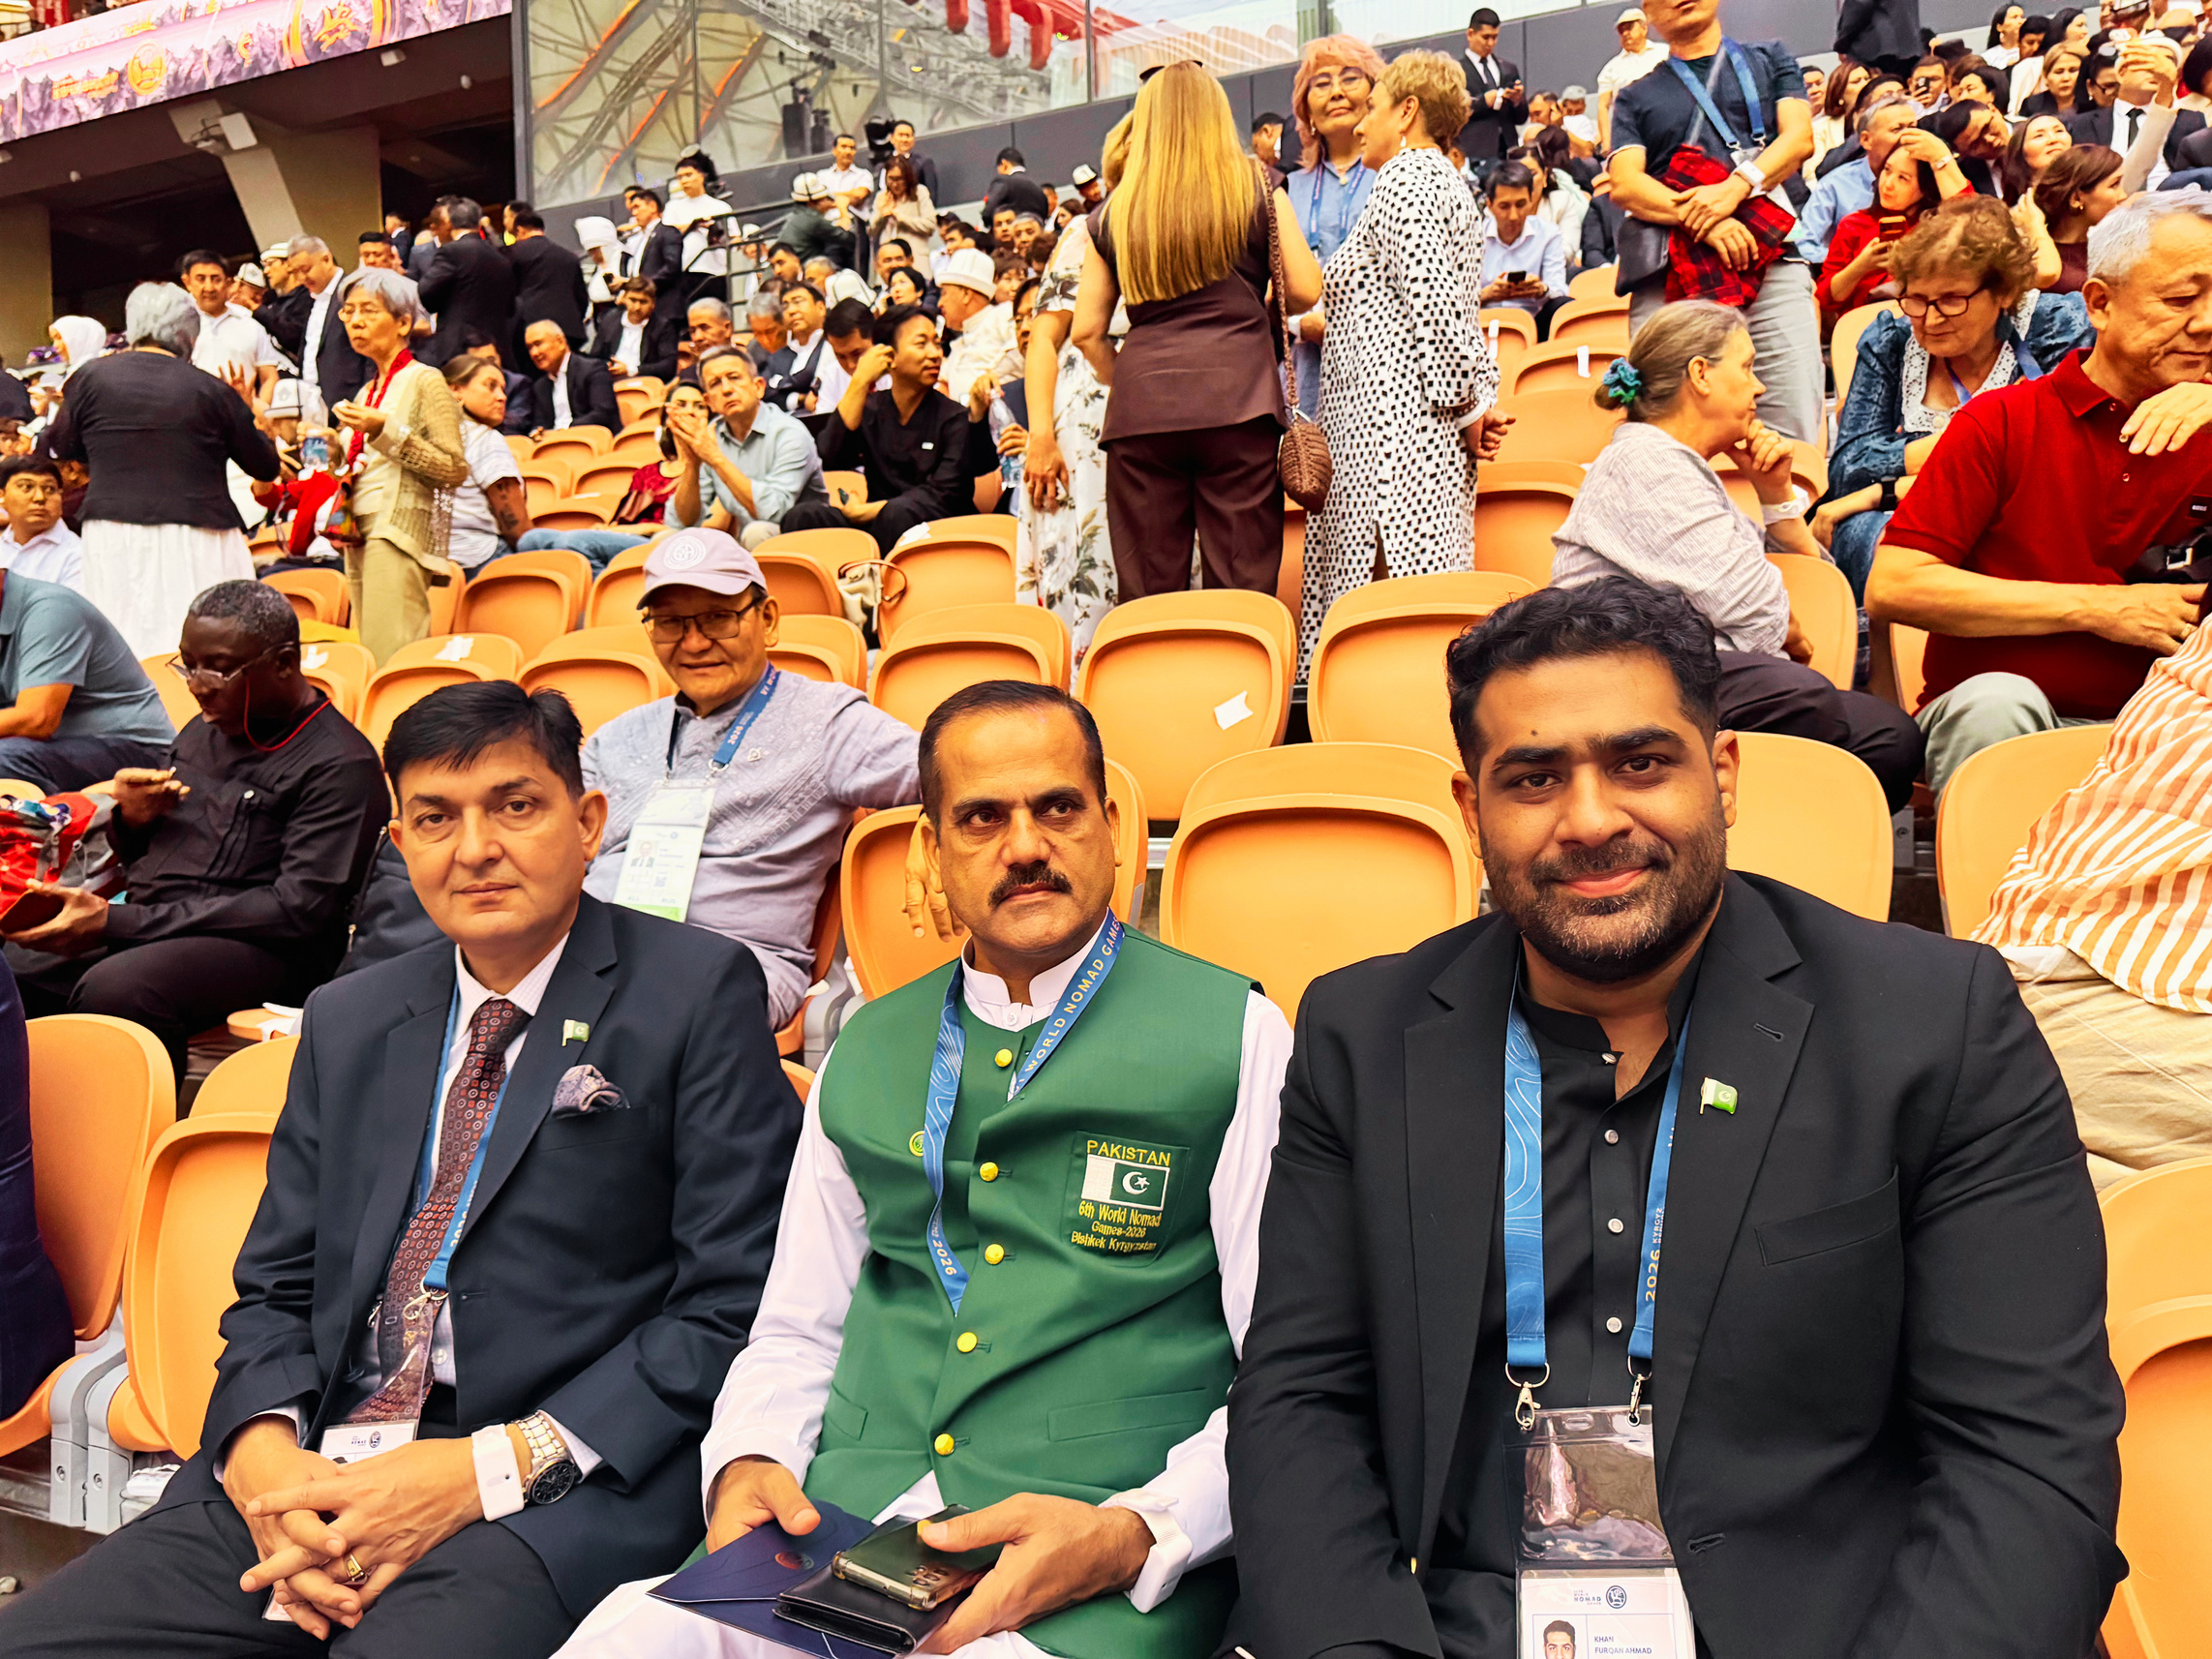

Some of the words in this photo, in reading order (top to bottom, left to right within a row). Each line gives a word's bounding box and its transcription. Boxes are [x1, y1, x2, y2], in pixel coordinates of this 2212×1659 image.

[1024, 1017, 1066, 1072] WORLD
[1063, 958, 1105, 1014] NOMAD
[1086, 1139, 1171, 1167] PAKISTAN
[1078, 1199, 1096, 1220] 6th
[1099, 1203, 1128, 1224] World
[1129, 1208, 1163, 1227] Nomad
[1091, 1221, 1147, 1238] Games-2026
[1651, 1207, 1663, 1245] KYRGYZ
[933, 1240, 958, 1276] 2026
[1646, 1250, 1661, 1302] 2026
